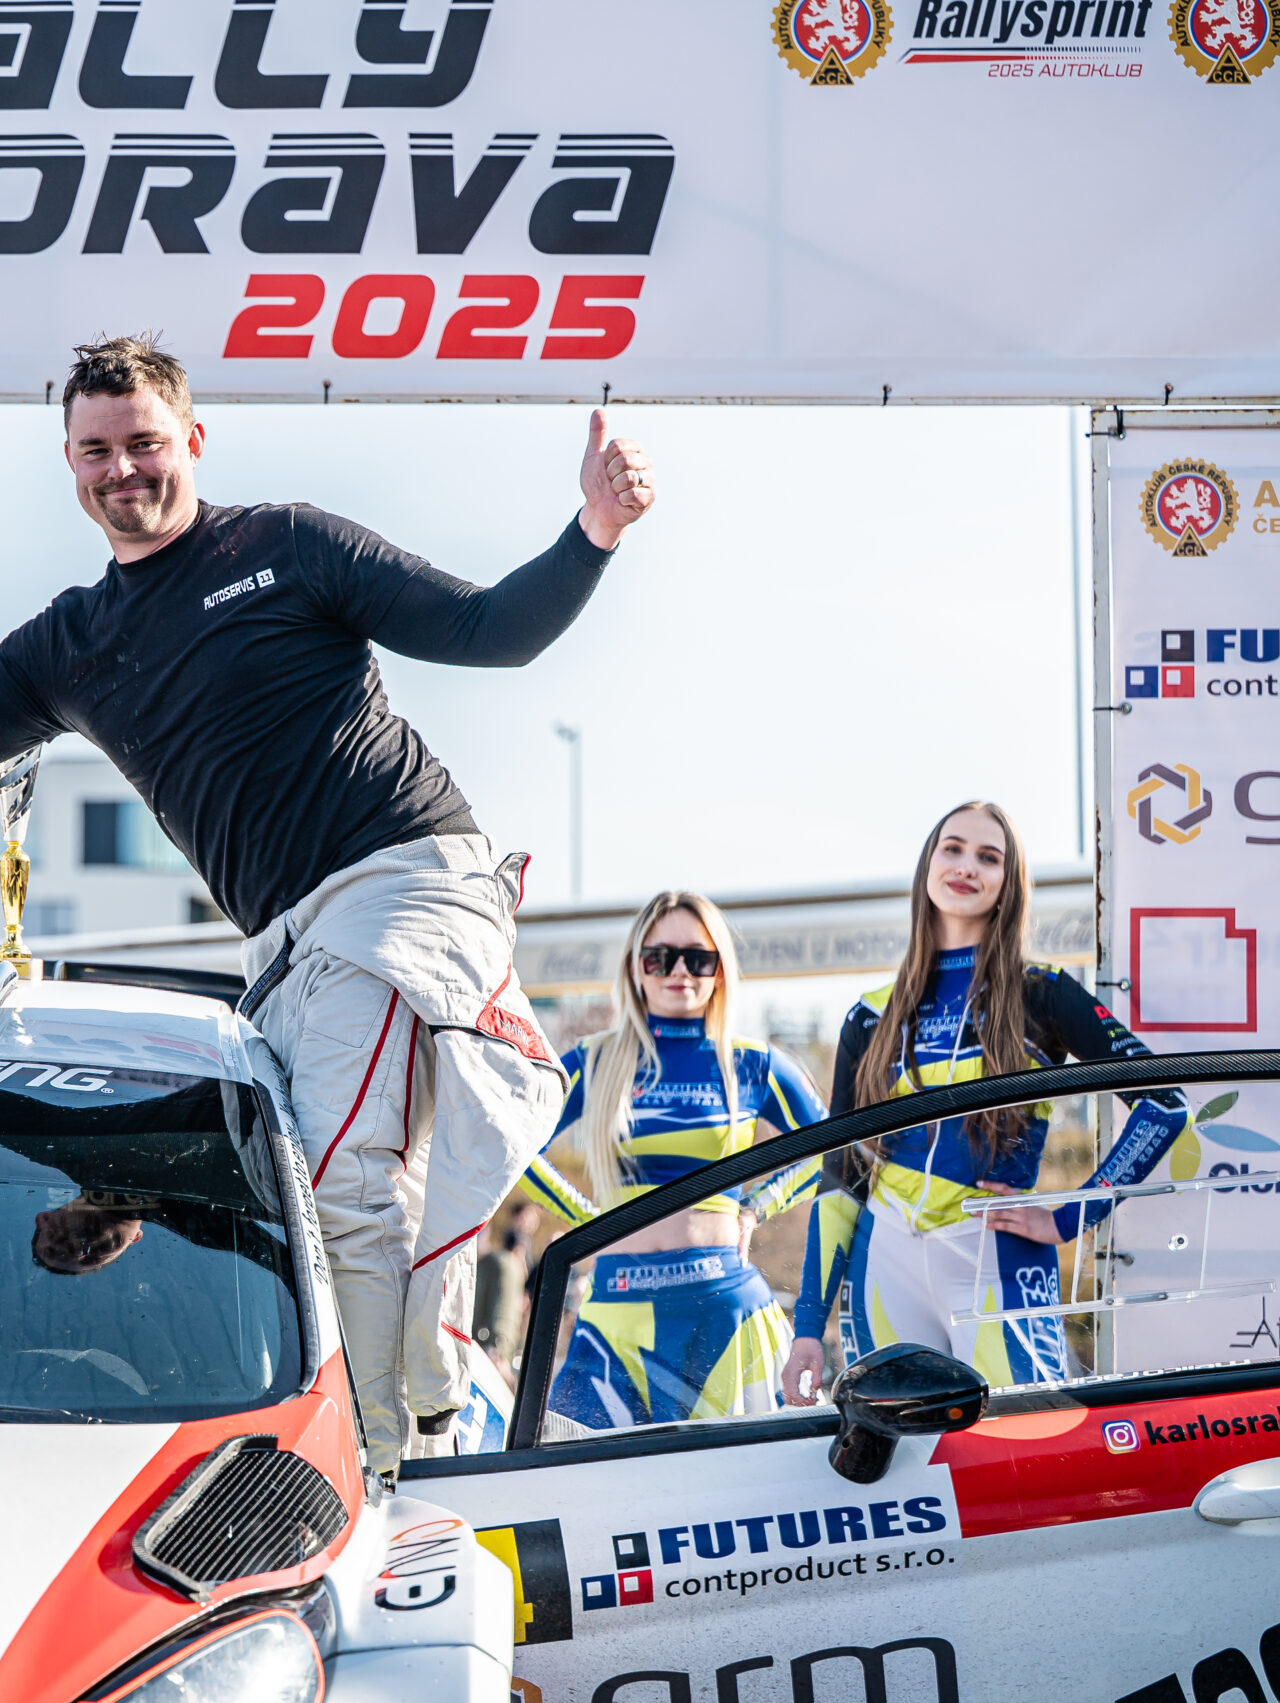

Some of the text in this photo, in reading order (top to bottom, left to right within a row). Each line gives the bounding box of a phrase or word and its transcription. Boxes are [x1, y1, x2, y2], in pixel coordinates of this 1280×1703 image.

[988, 64, 1142, 77] 2025 AUTOKLUB
[222, 274, 646, 360] 2025
[203, 576, 256, 610] AUTOSERVIS
[658, 1496, 947, 1565] FUTURES
[665, 1547, 956, 1598] contproduct s.r.o.
